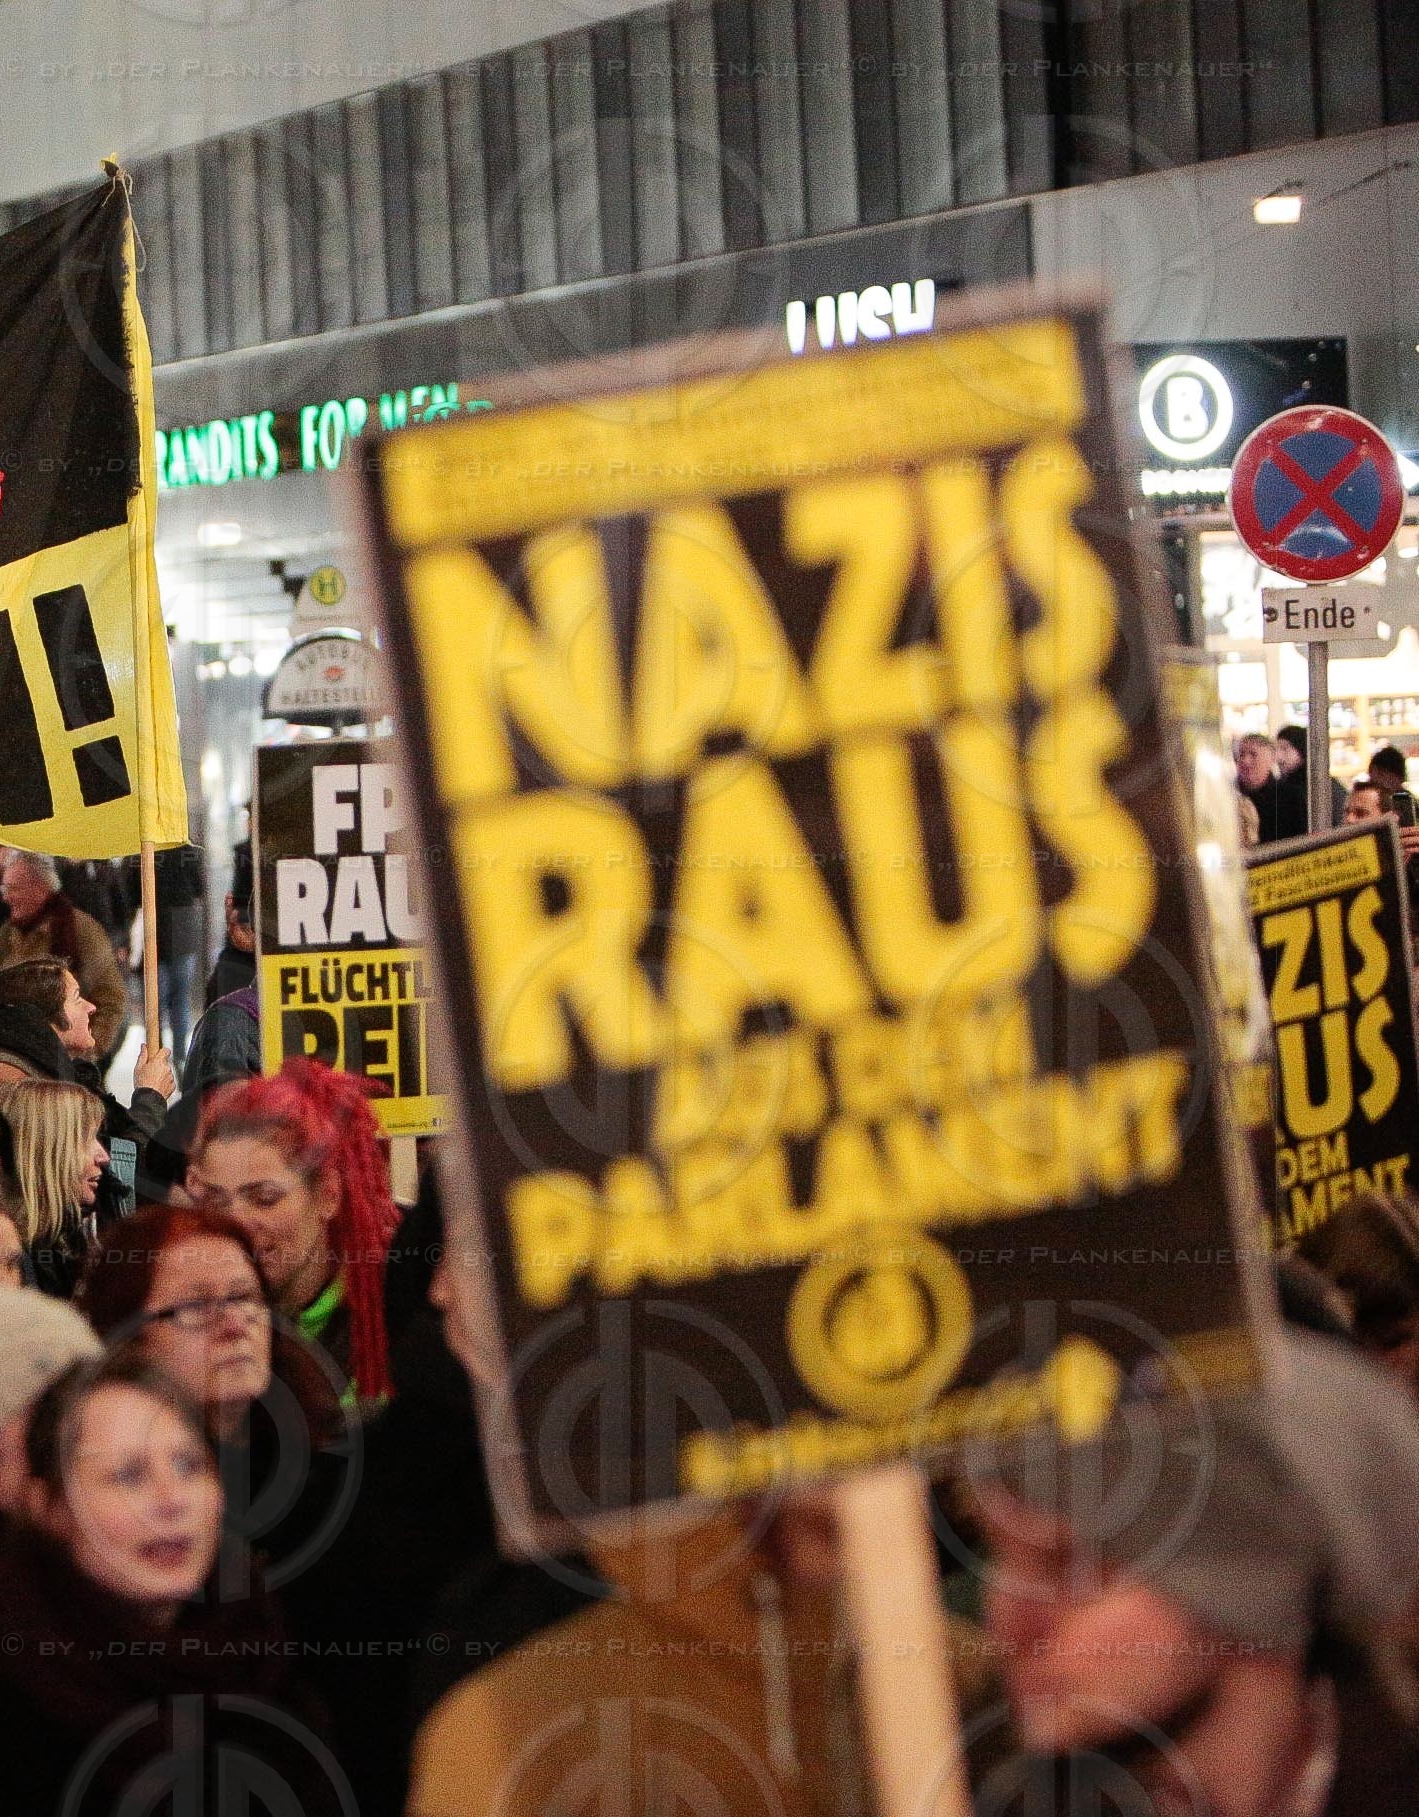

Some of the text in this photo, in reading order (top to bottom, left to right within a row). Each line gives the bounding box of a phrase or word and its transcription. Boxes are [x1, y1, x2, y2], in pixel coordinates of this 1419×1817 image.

[402, 436, 1120, 800] NAZIS
[1284, 598, 1356, 630] Ende
[448, 686, 1157, 1092] RAUS
[508, 1053, 1190, 1307] PARLAMENT
